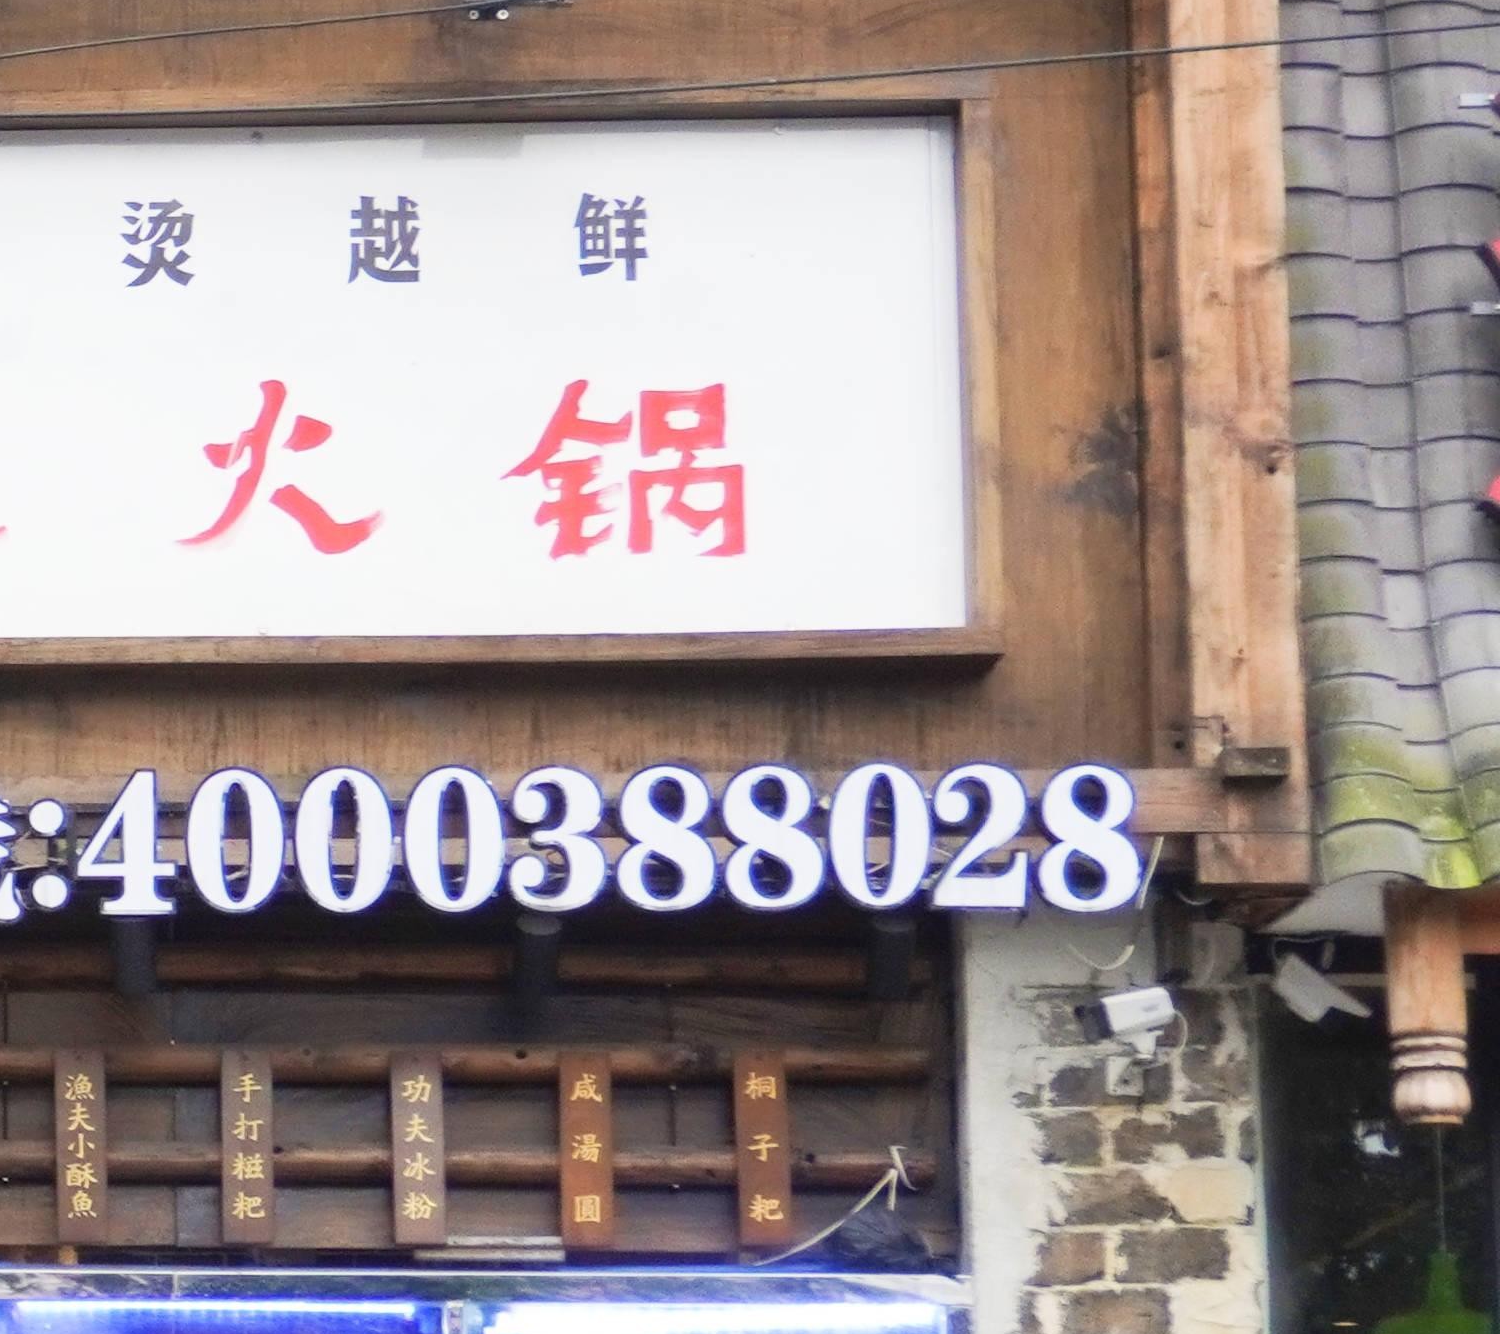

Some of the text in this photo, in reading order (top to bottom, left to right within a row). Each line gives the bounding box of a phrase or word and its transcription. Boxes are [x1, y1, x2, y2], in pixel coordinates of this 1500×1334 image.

[65, 1075, 98, 1220] 漁夫小酥魚
[232, 1073, 266, 1221] 手打糍粑
[400, 1074, 437, 1221] 功夫冰粉
[570, 1073, 603, 1223] 咸湯圓
[744, 1071, 785, 1223] 桐子粑
